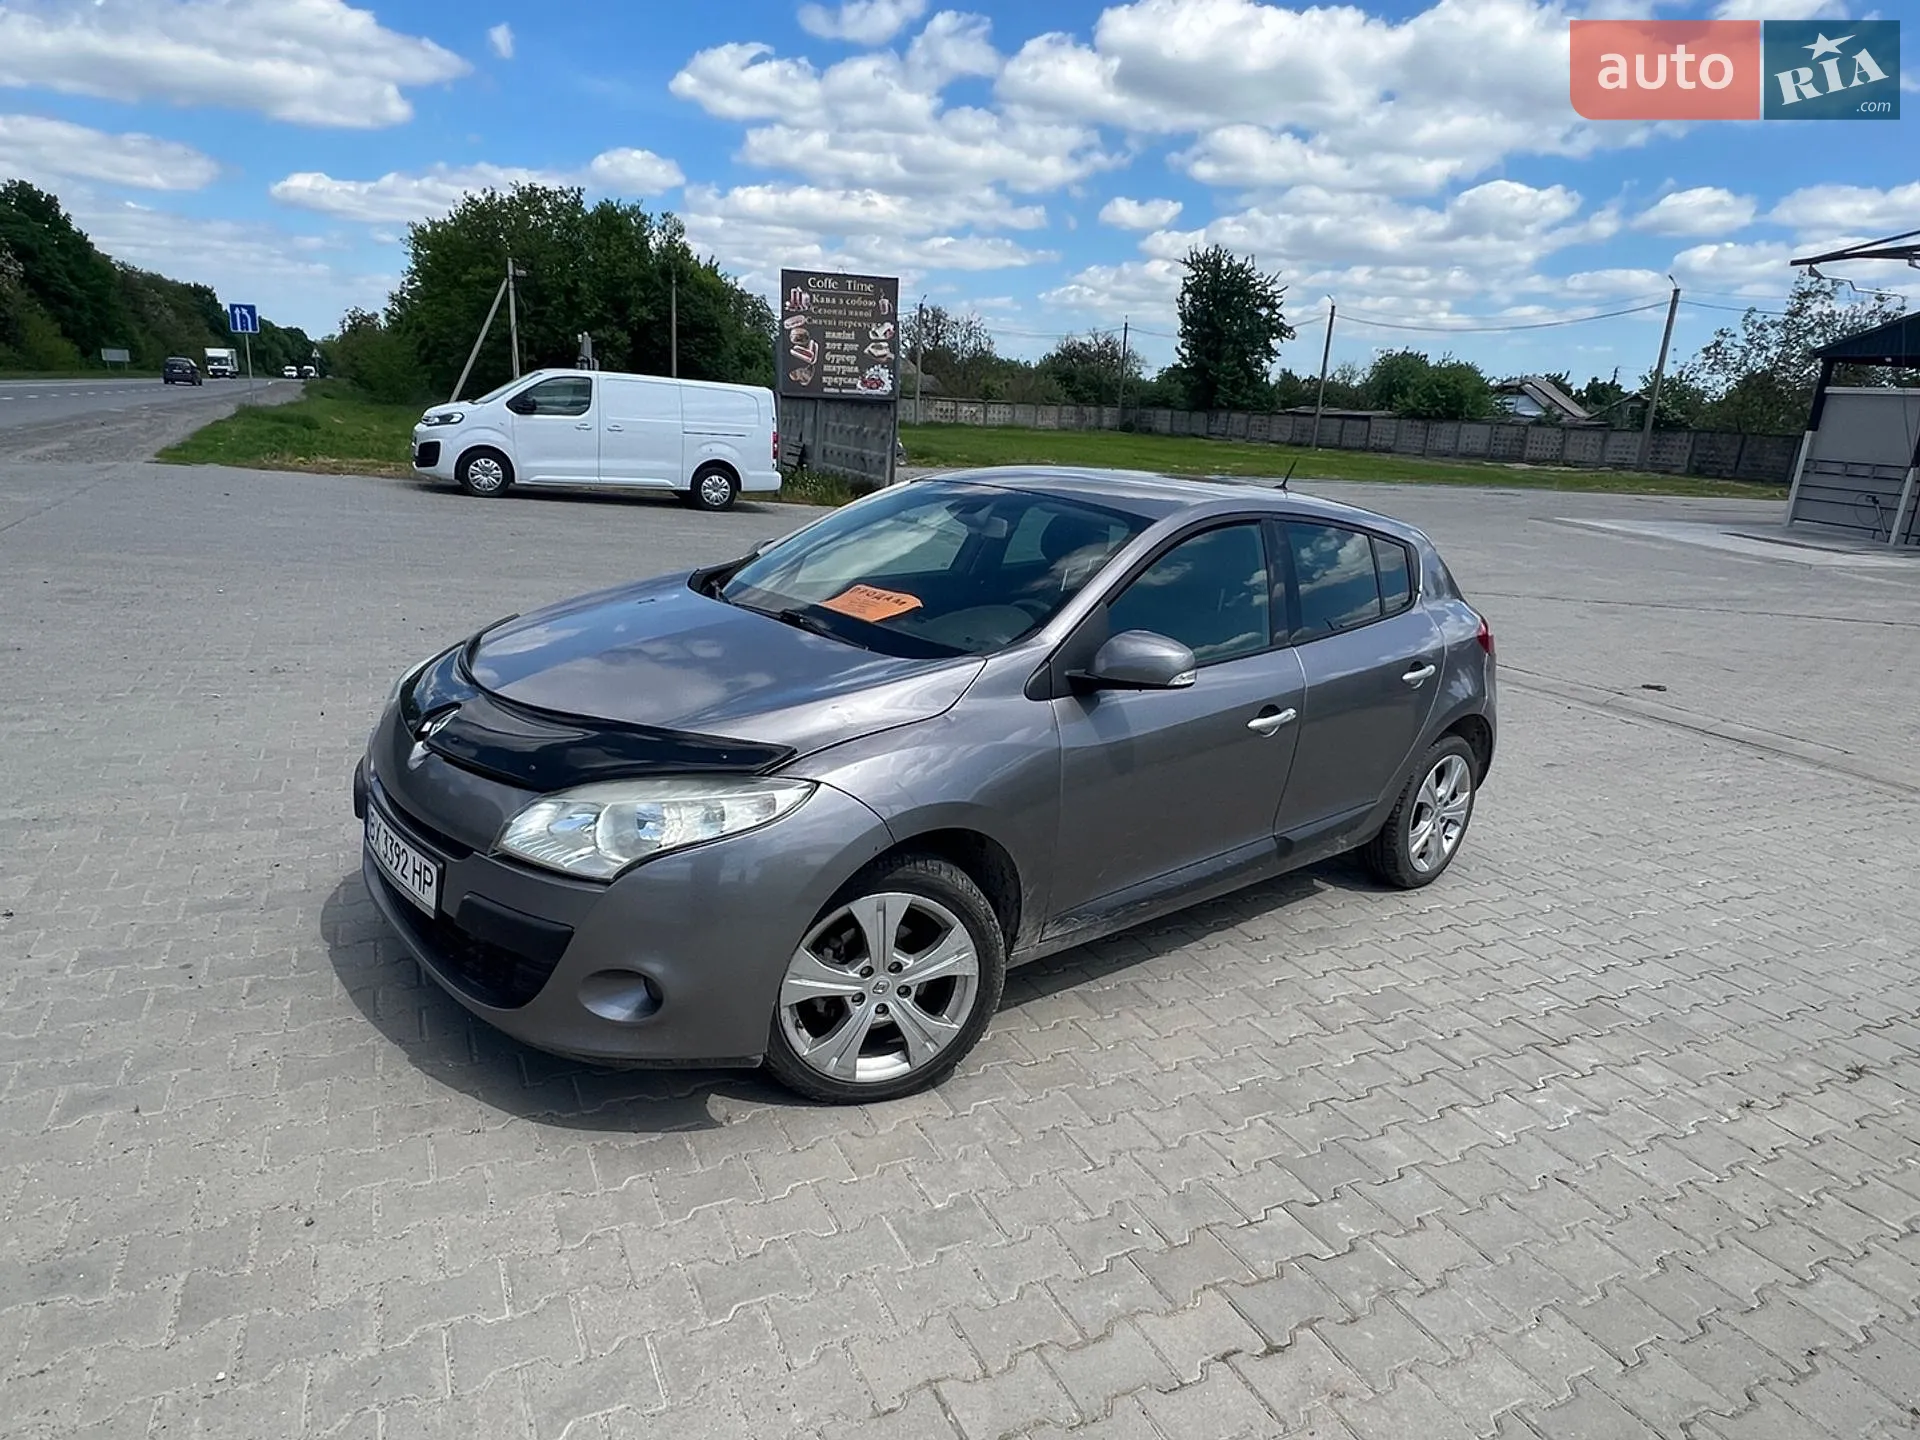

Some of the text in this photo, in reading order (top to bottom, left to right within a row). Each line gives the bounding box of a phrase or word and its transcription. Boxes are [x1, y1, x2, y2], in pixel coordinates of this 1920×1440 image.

[807, 277, 875, 292] Coffe Time
[812, 293, 836, 304] Кава
[845, 296, 876, 307] собою
[825, 350, 857, 365] бургер
[823, 360, 859, 375] шаурма
[383, 829, 409, 881] 3392
